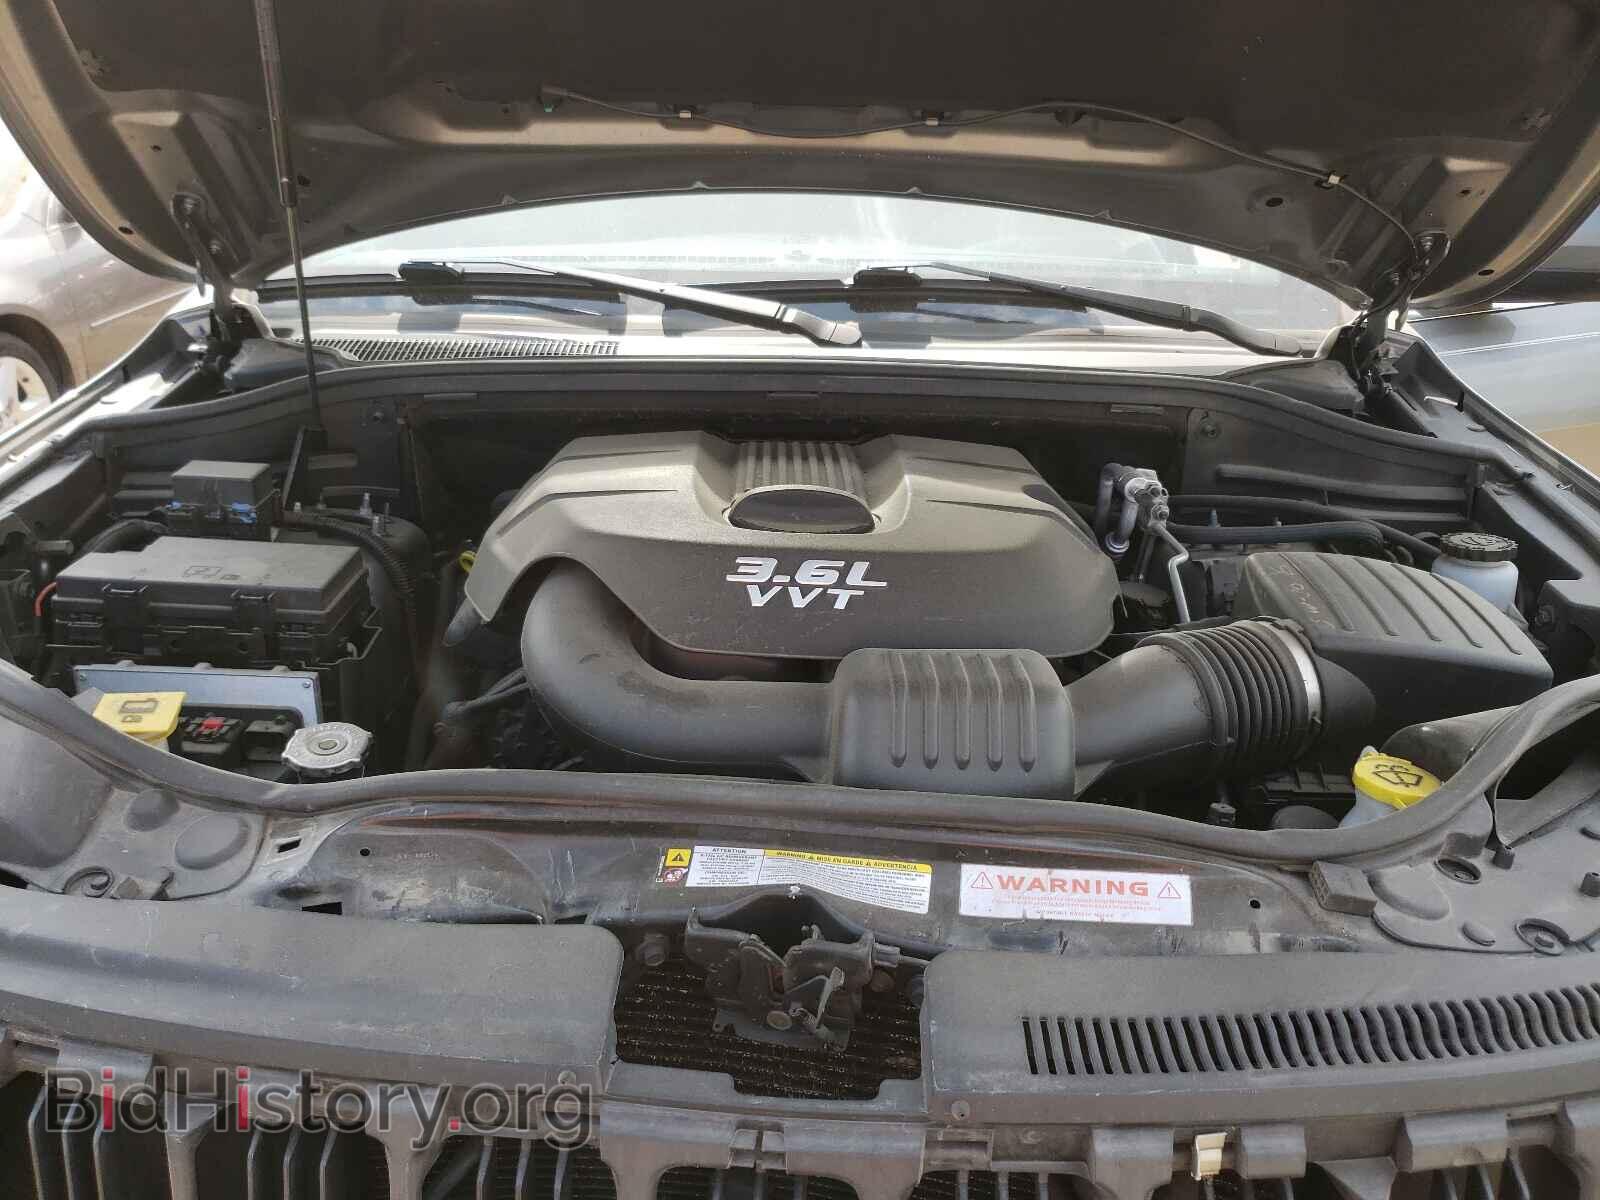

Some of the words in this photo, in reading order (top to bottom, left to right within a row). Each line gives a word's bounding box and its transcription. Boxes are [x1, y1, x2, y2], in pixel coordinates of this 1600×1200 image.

[725, 556, 888, 587] 3.6L
[746, 584, 865, 610] VVT
[776, 851, 806, 860] WARNING
[843, 858, 864, 866] GARDE
[873, 861, 917, 871] ADVERTENCIA
[996, 874, 1149, 897] WARNING
